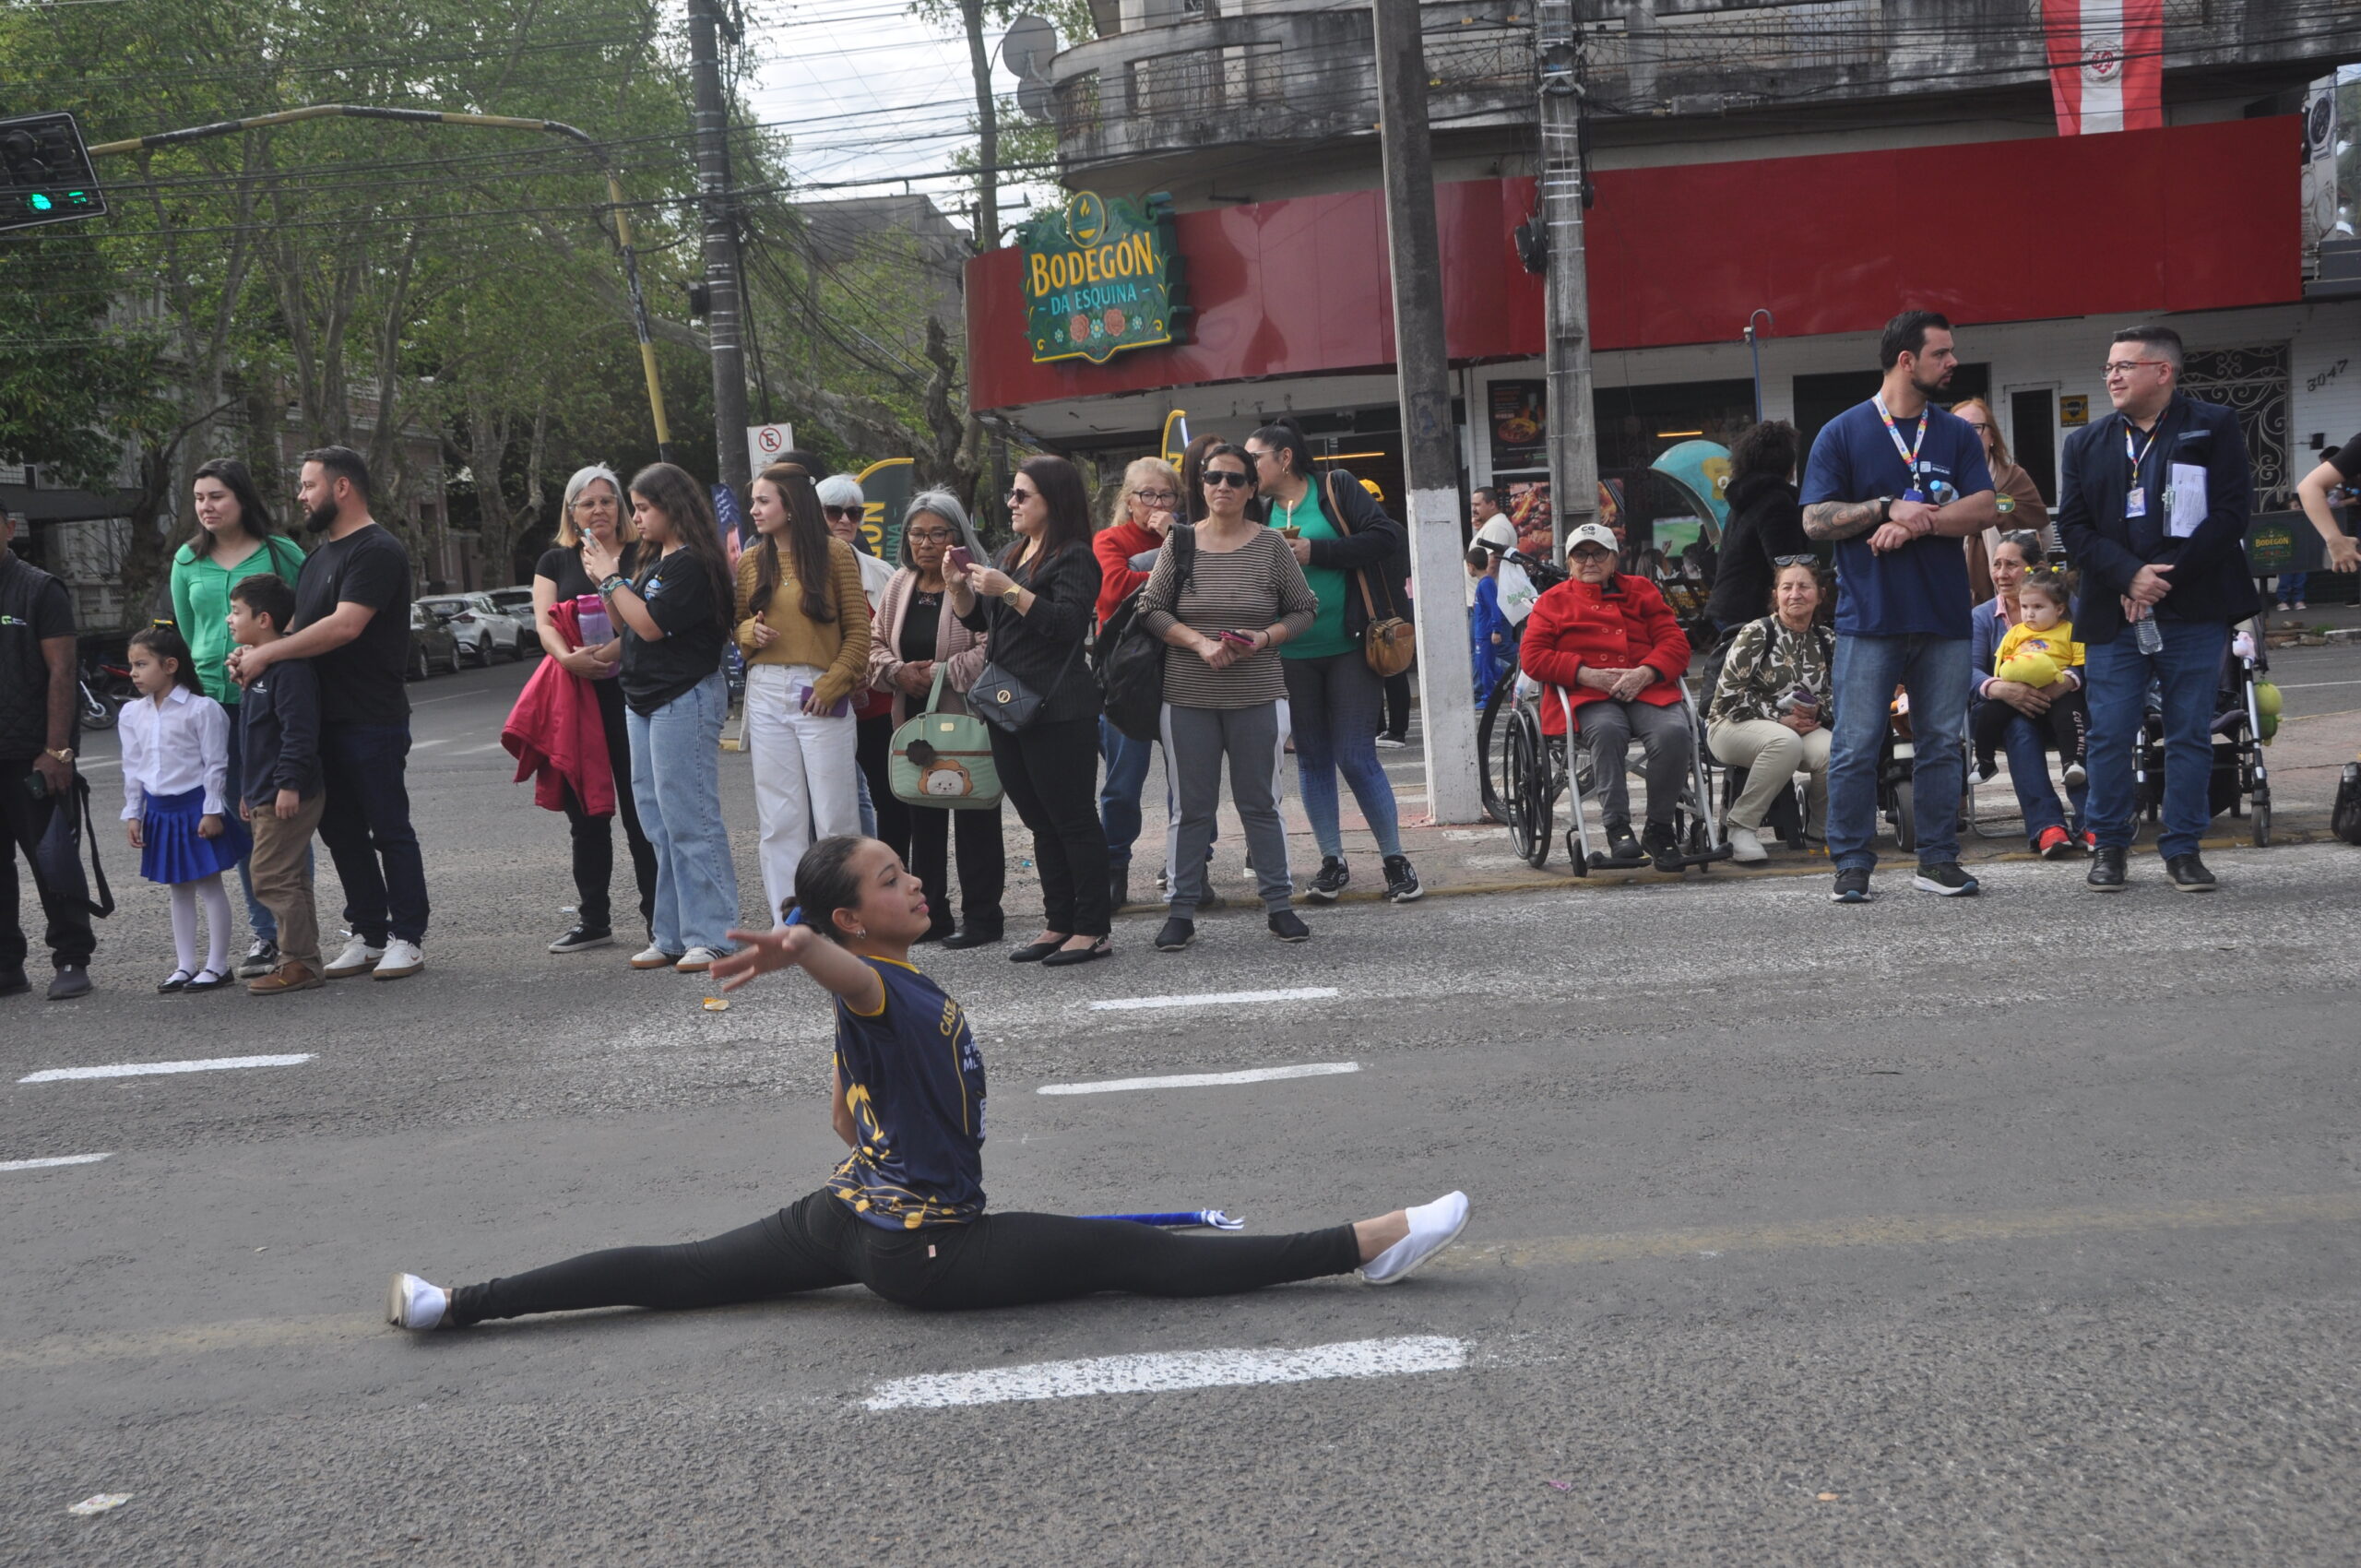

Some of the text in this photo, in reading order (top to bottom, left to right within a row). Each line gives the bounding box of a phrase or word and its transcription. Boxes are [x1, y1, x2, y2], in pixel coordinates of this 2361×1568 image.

[1030, 232, 1154, 298] BODEGÓN
[1050, 282, 1138, 315] DA ESQUINA
[2307, 358, 2348, 392] 3047
